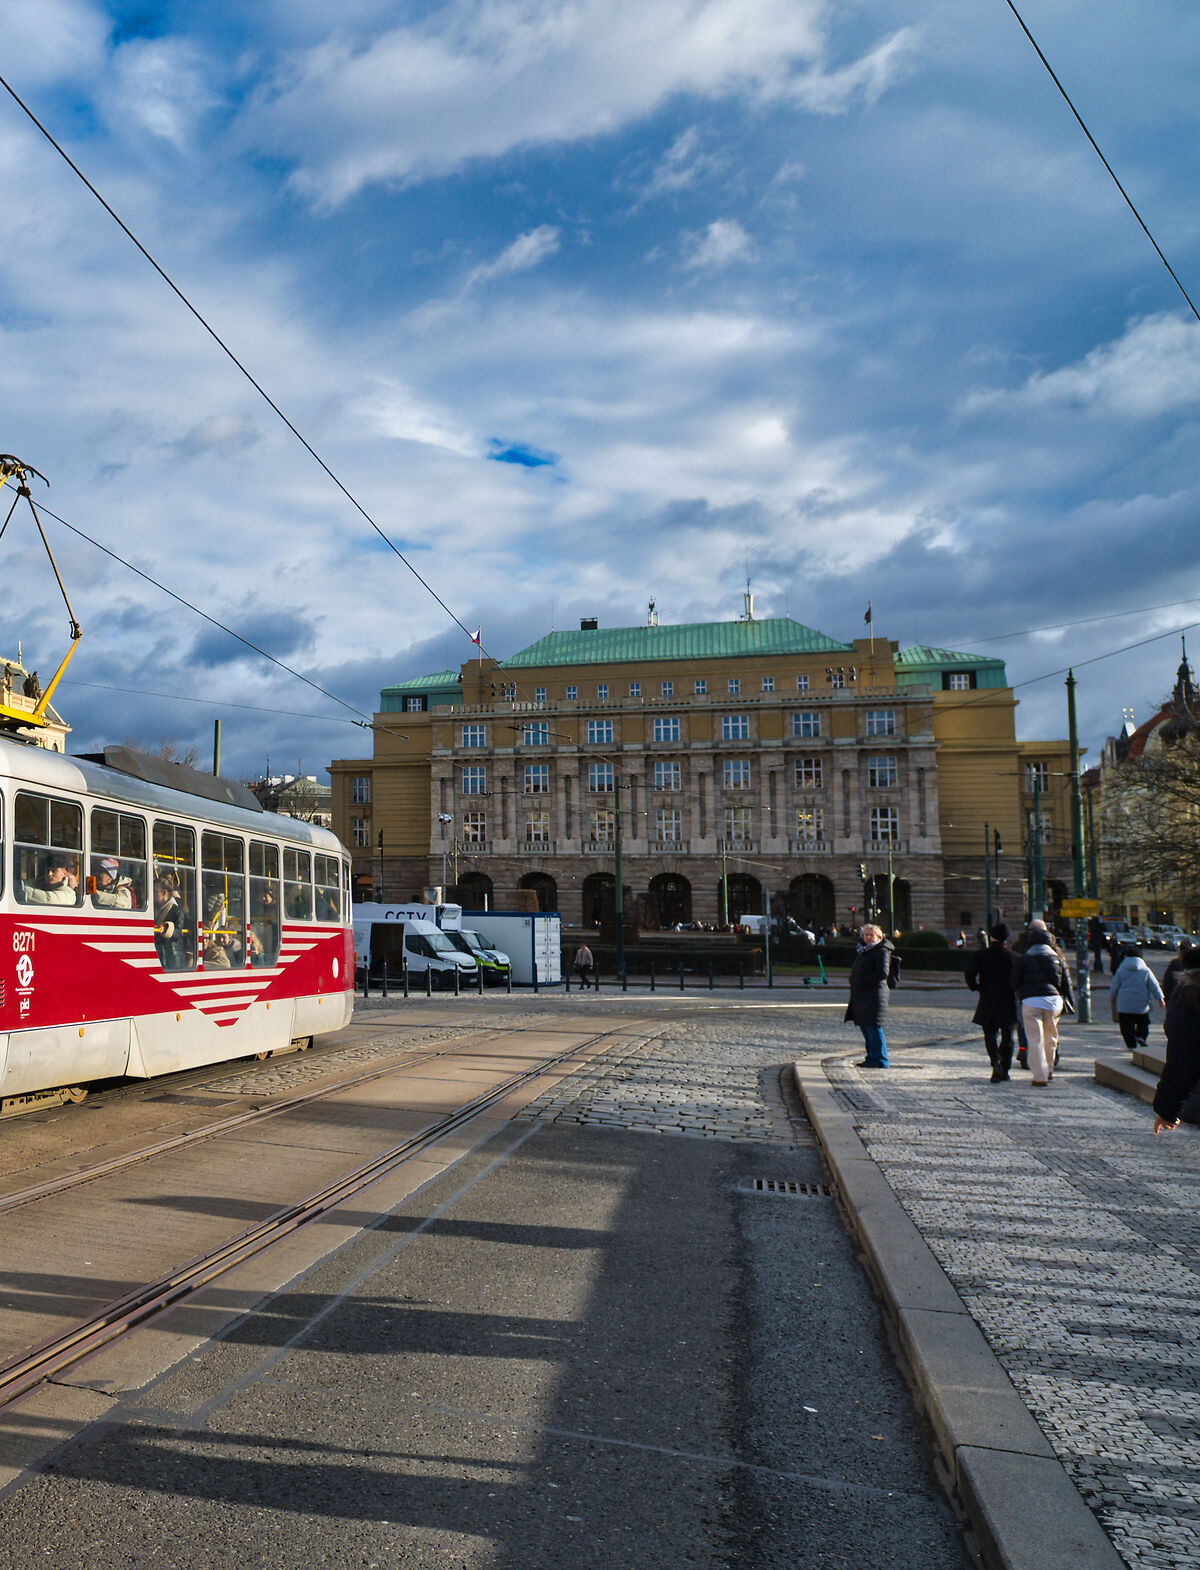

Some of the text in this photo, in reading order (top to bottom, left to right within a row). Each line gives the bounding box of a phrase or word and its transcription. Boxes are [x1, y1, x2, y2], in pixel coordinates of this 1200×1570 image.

[384, 911, 426, 920] CCTV
[13, 931, 35, 952] 8271
[20, 997, 30, 1013] pid
